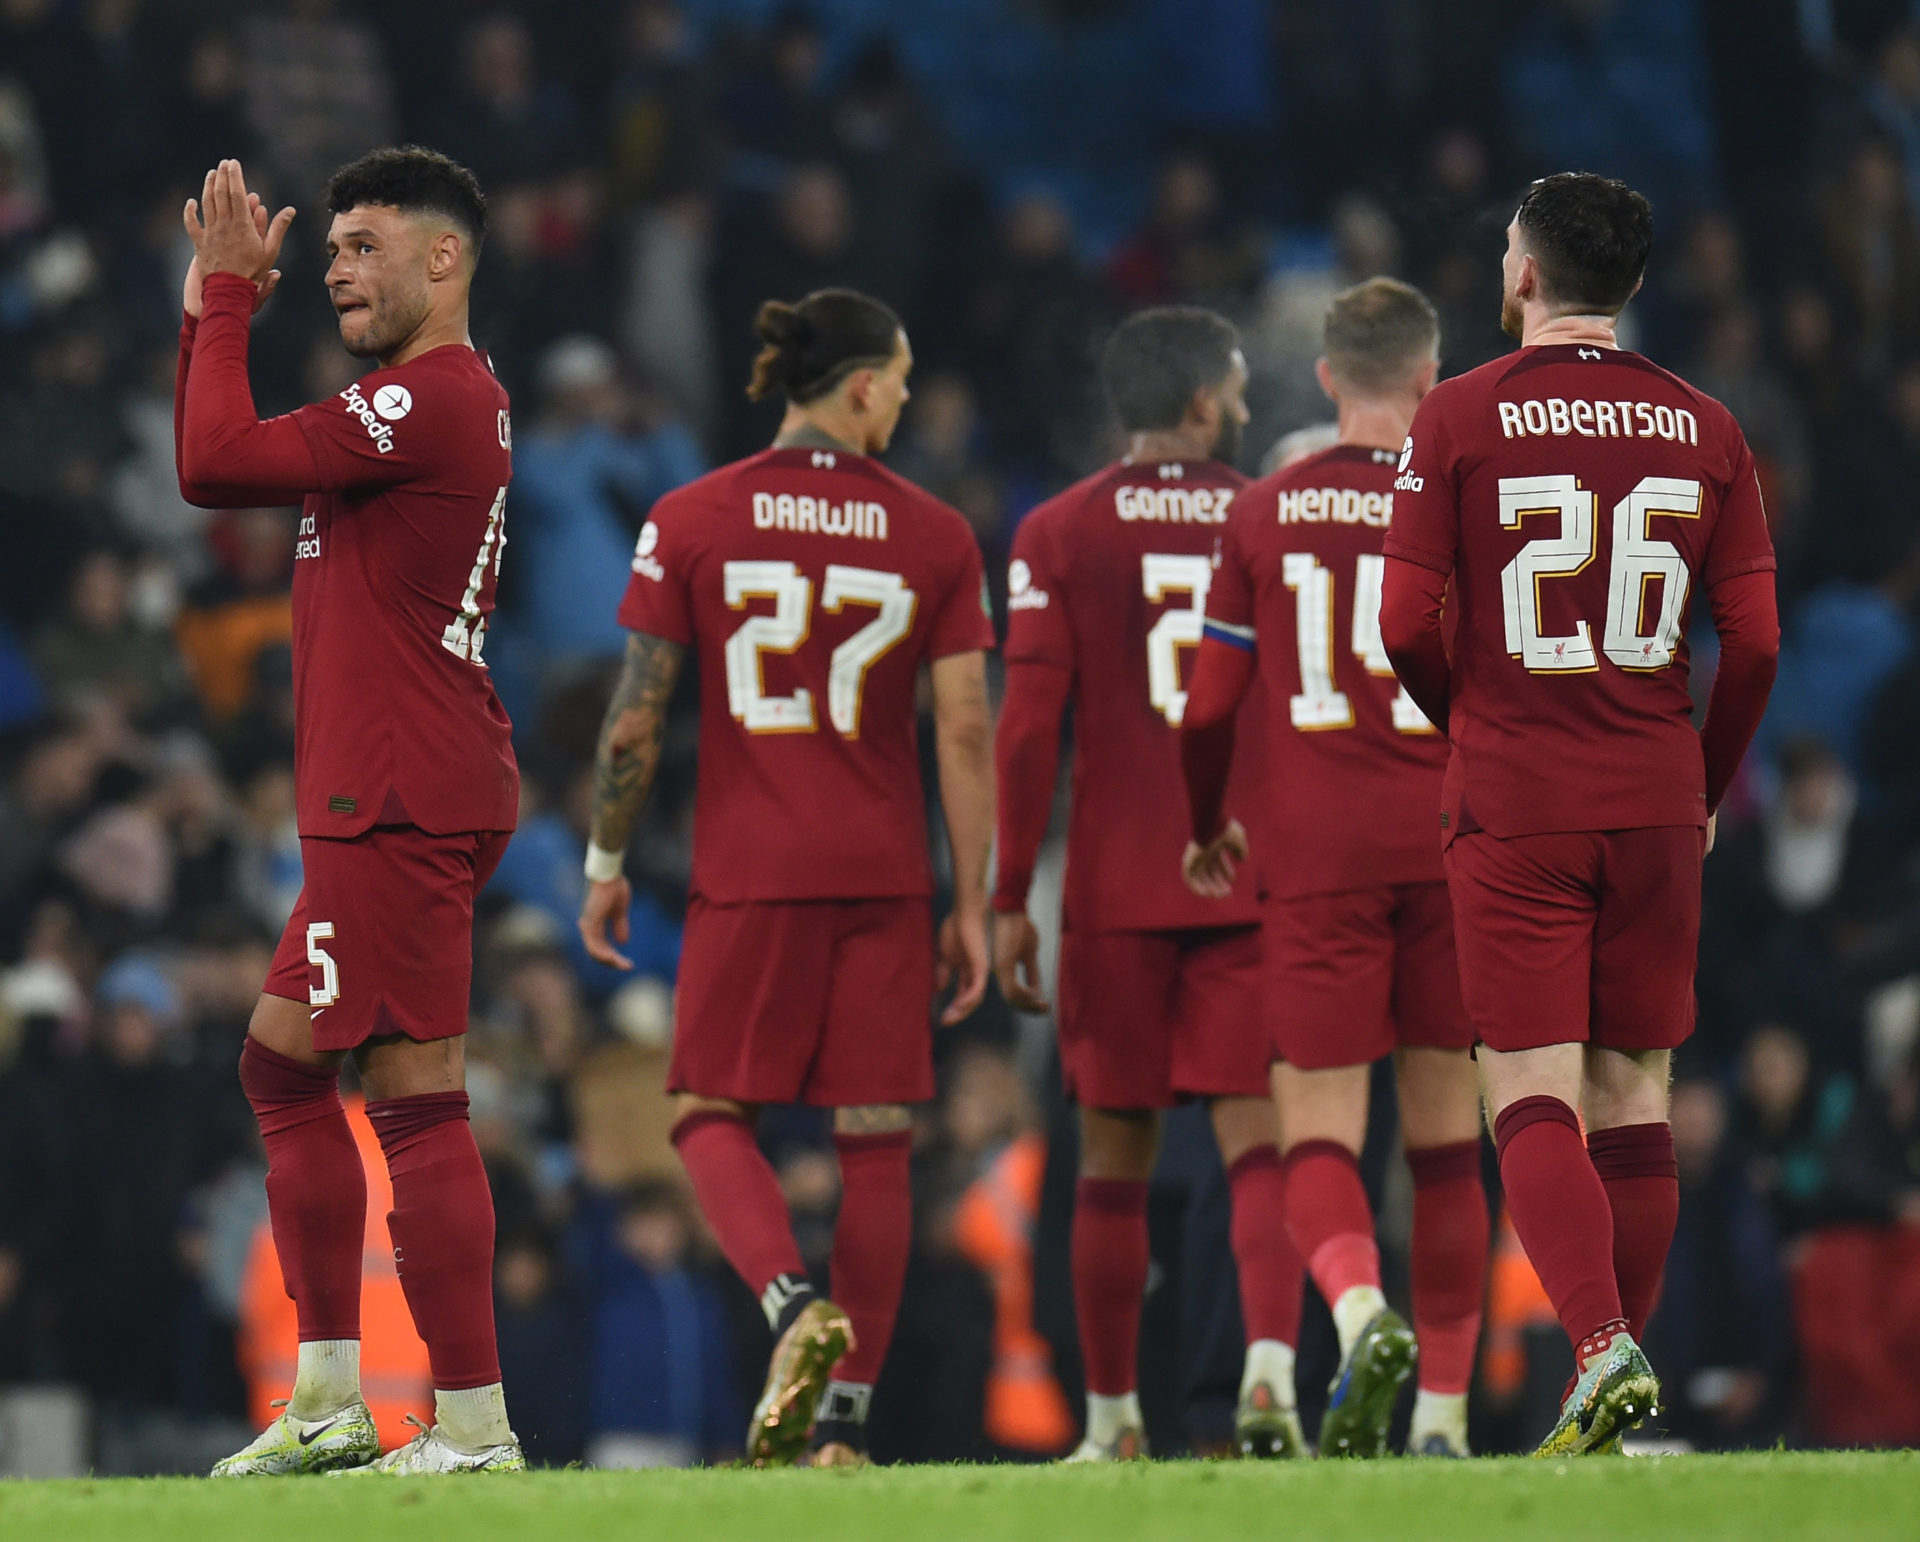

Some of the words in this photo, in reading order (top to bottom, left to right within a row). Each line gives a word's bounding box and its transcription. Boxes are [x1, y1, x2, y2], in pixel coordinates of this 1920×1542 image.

[340, 383, 394, 454] Expedia
[752, 492, 889, 540] DARWIN
[1394, 468, 1424, 493] edia
[1498, 474, 1704, 673] 26
[723, 560, 919, 741] 27
